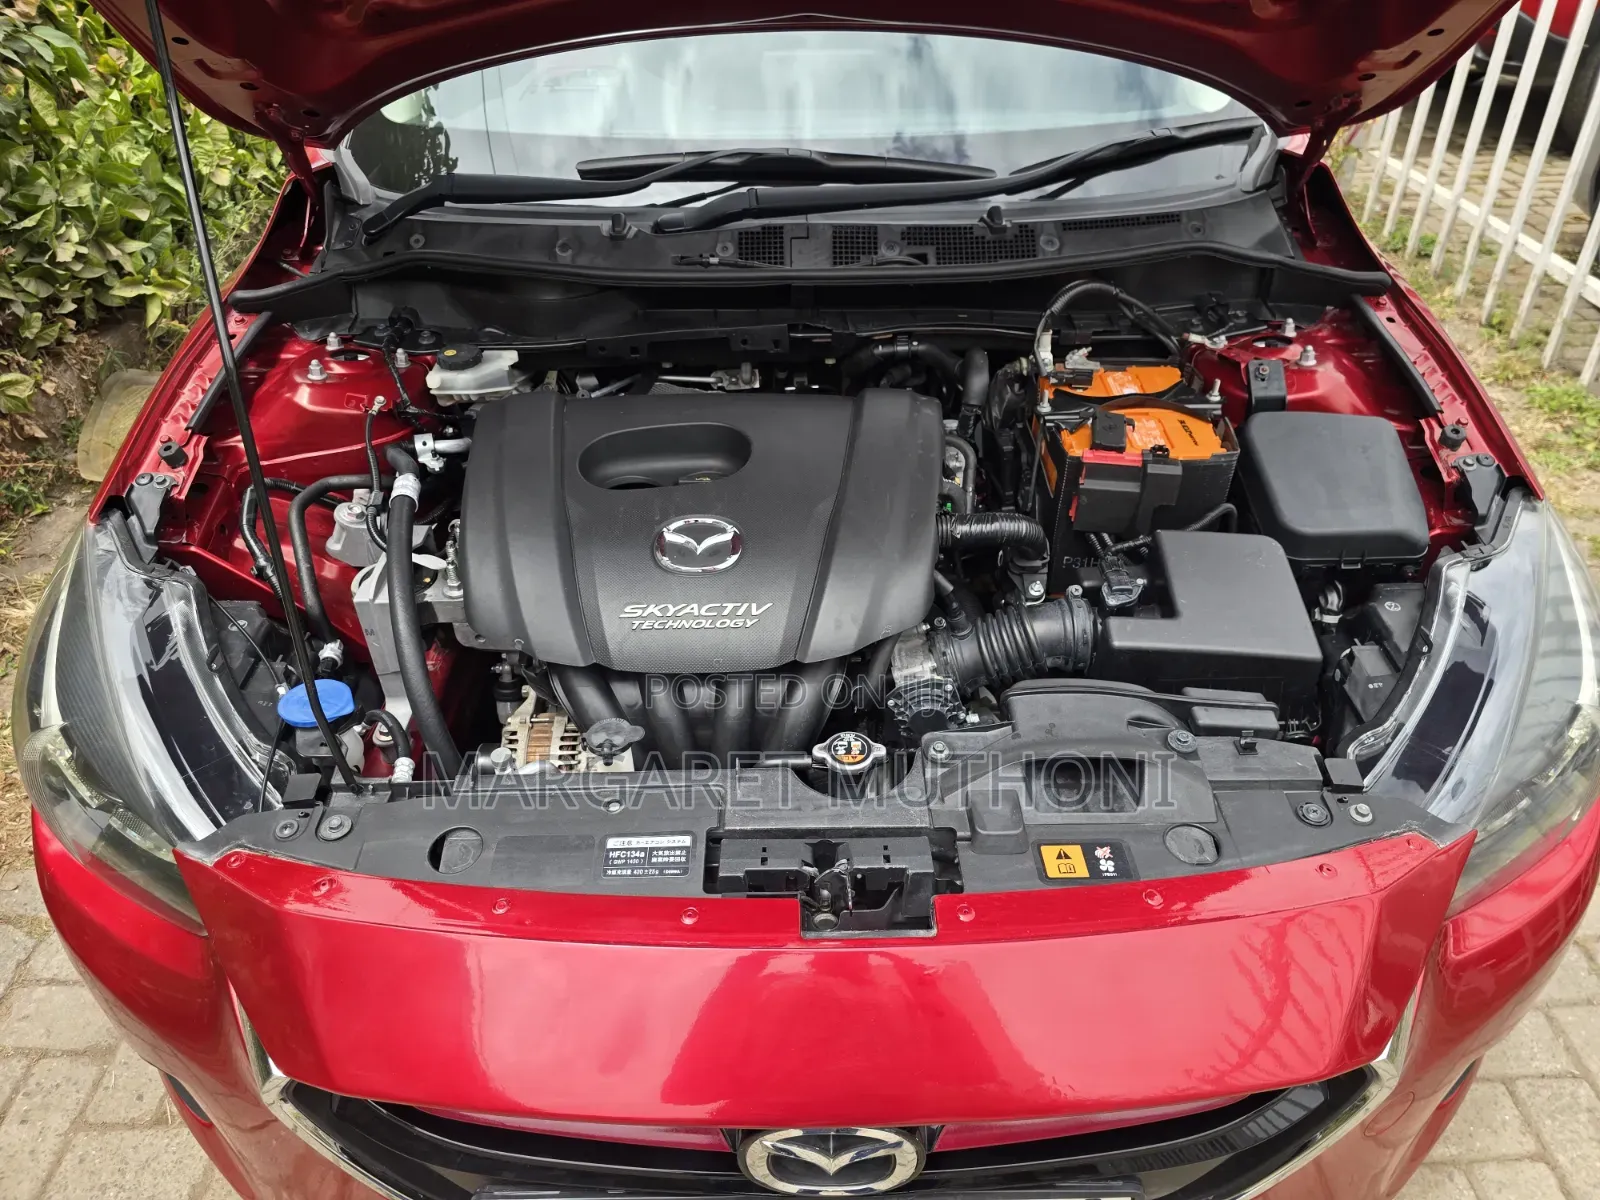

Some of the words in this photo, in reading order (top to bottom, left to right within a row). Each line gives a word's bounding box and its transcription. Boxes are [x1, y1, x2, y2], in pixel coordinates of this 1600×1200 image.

[619, 602, 773, 618] SKYACTIV
[631, 619, 759, 630] TECHNOLOGY
[609, 850, 645, 858] HFC134a
